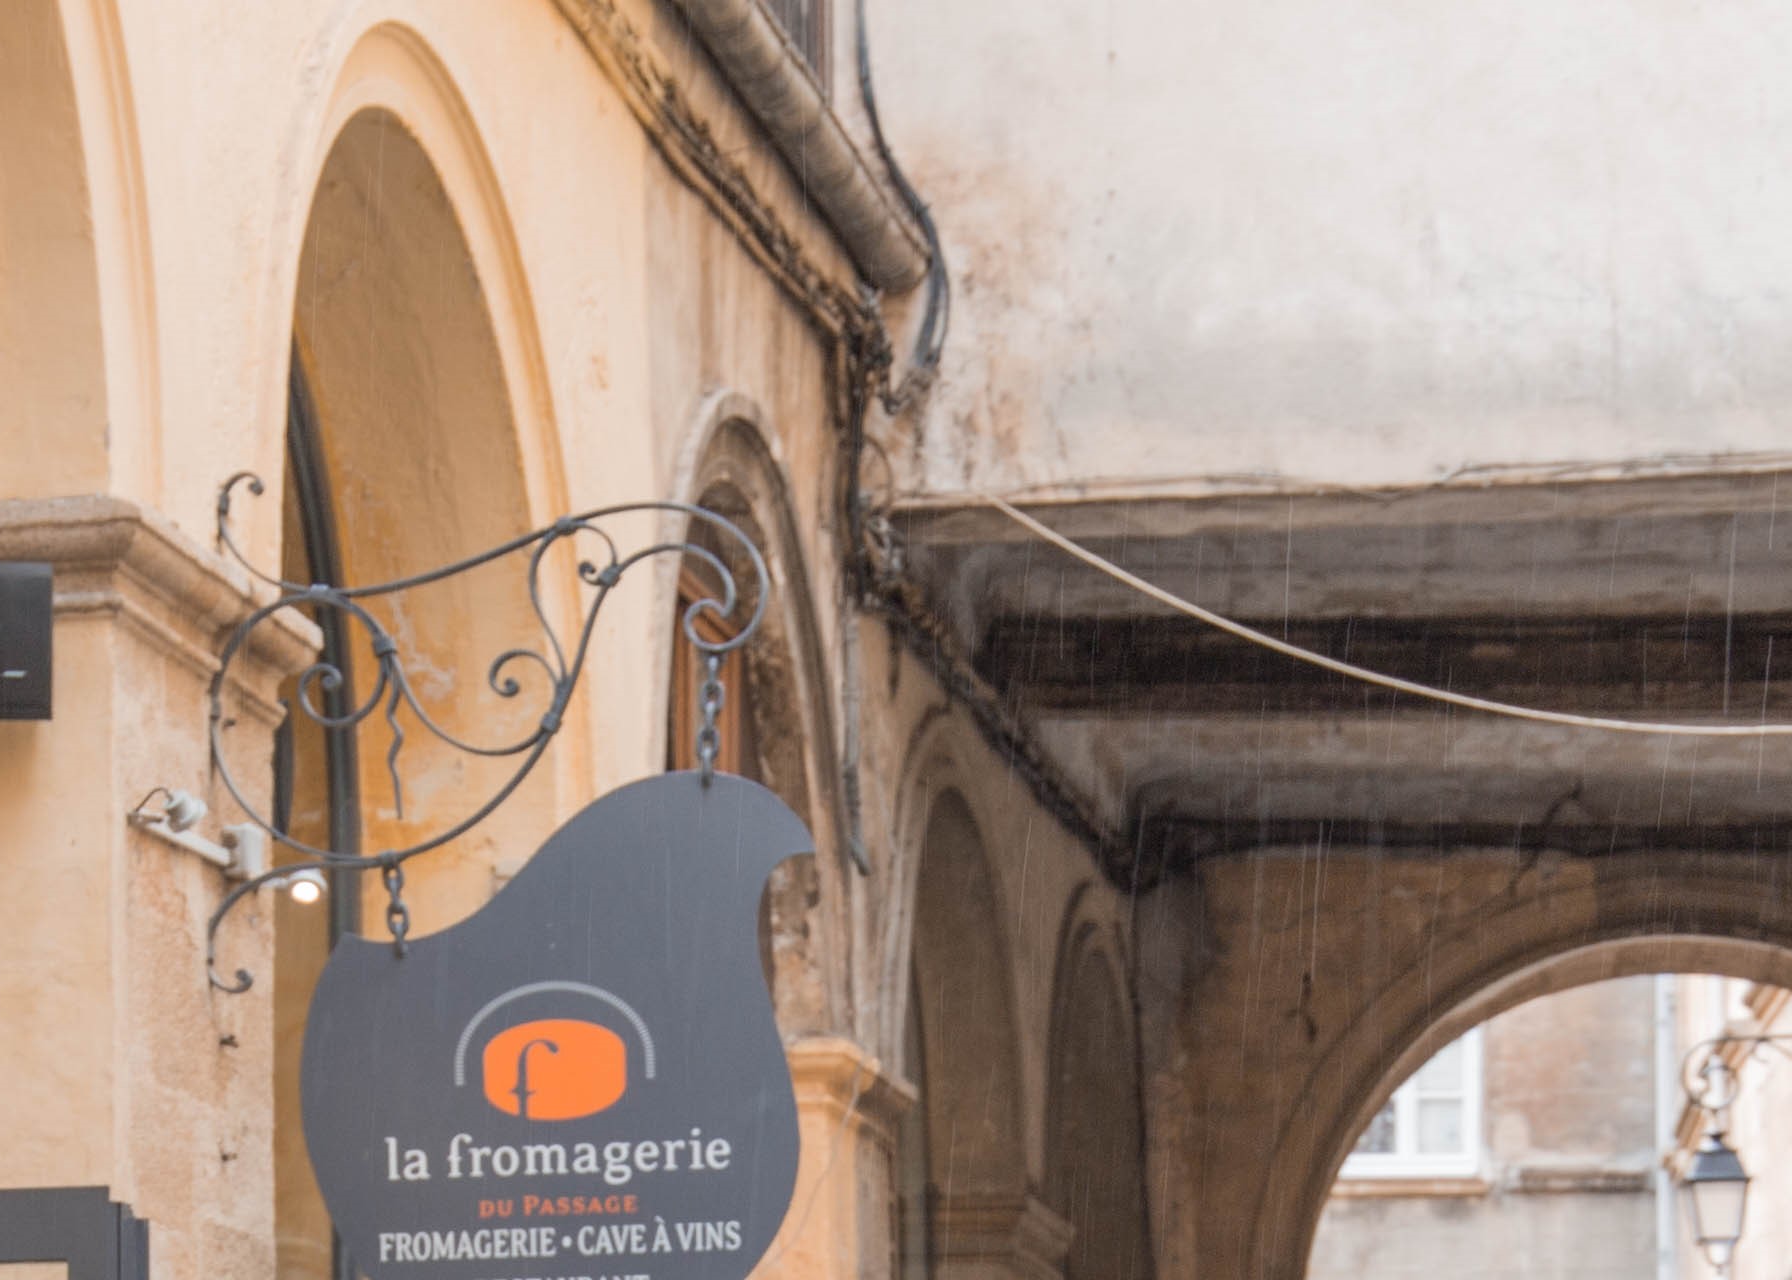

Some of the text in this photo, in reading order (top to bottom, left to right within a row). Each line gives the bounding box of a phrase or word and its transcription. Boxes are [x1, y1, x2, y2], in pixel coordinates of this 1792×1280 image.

[384, 1127, 732, 1185] la fromagerie
[478, 1194, 640, 1219] DU PASSAGE
[378, 1216, 743, 1262] FROMAGERIE CAVE À VINS
